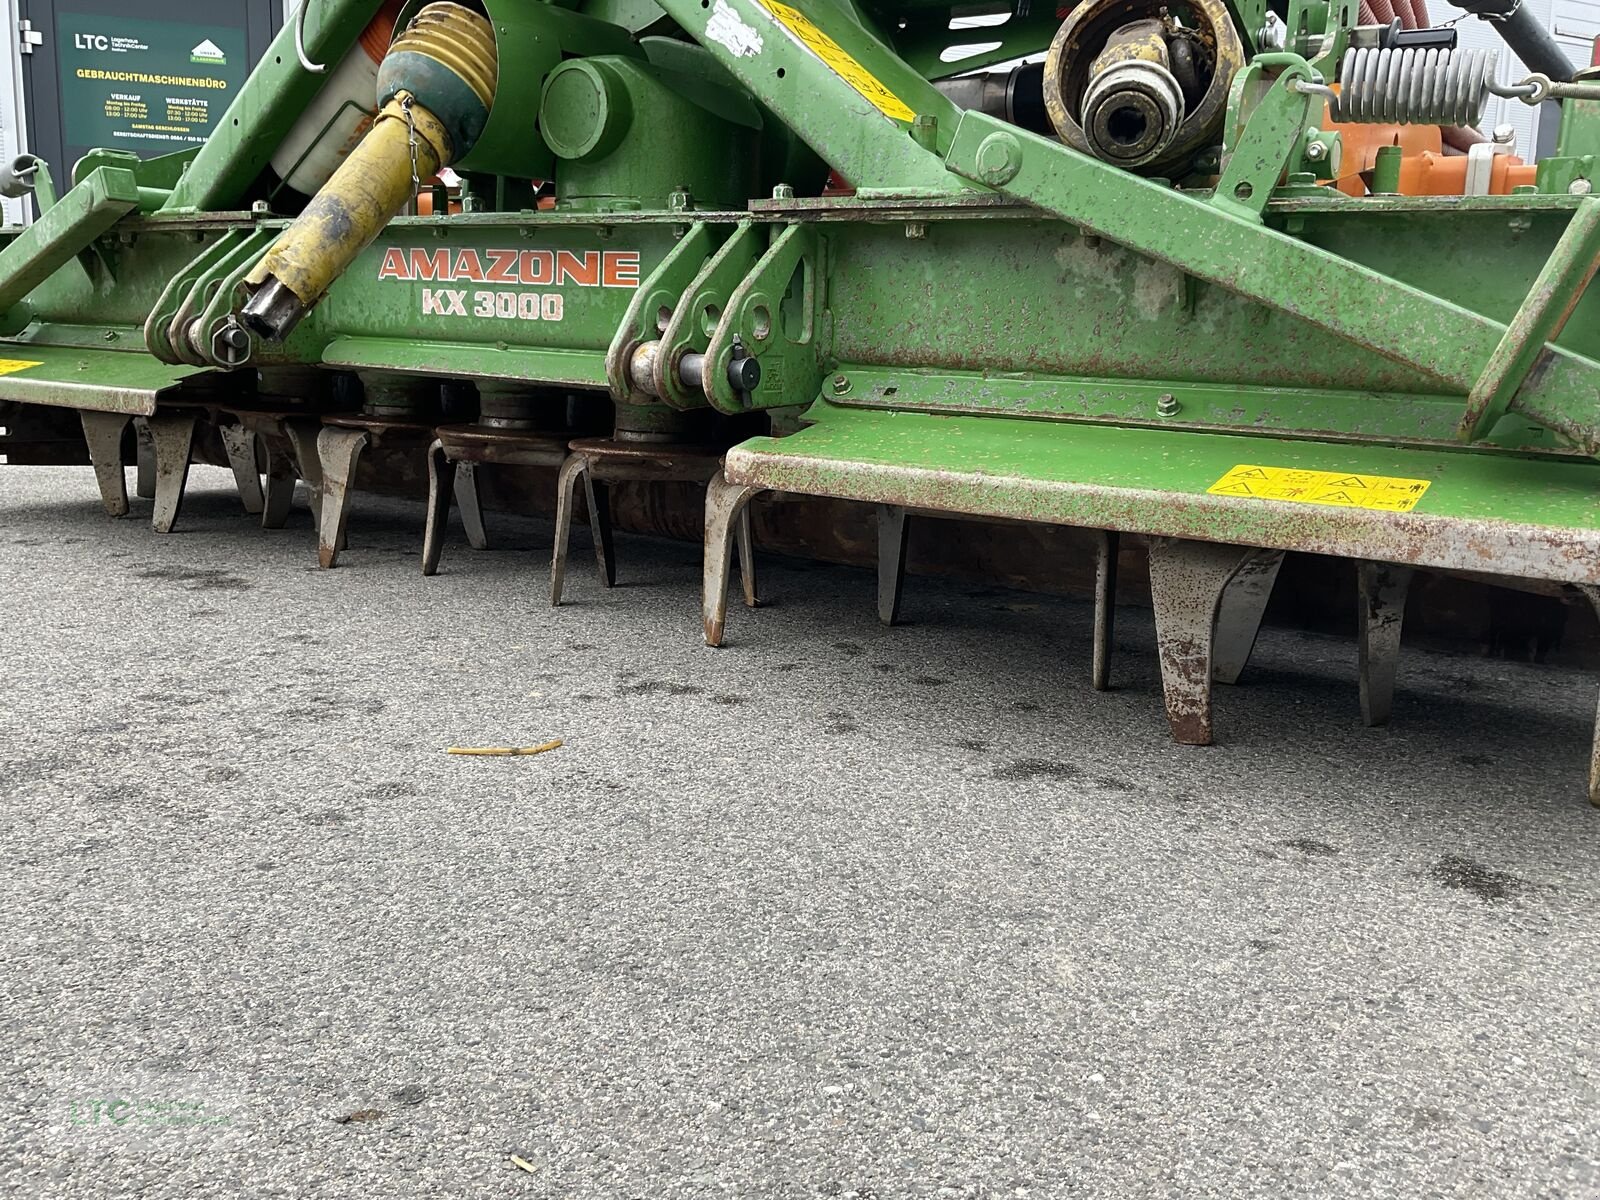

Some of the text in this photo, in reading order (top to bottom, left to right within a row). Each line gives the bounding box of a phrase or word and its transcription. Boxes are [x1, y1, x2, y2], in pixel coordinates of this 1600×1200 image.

[74, 33, 109, 51] LTC
[111, 36, 139, 45] Lagerhaus
[76, 68, 227, 89] GEBRAUCHTMASCHINENBÜRO
[110, 93, 141, 102] VERKAUF
[165, 97, 208, 107] WERKSTÄTTE
[378, 247, 640, 288] AMAZONE
[422, 288, 564, 321] KX 3000
